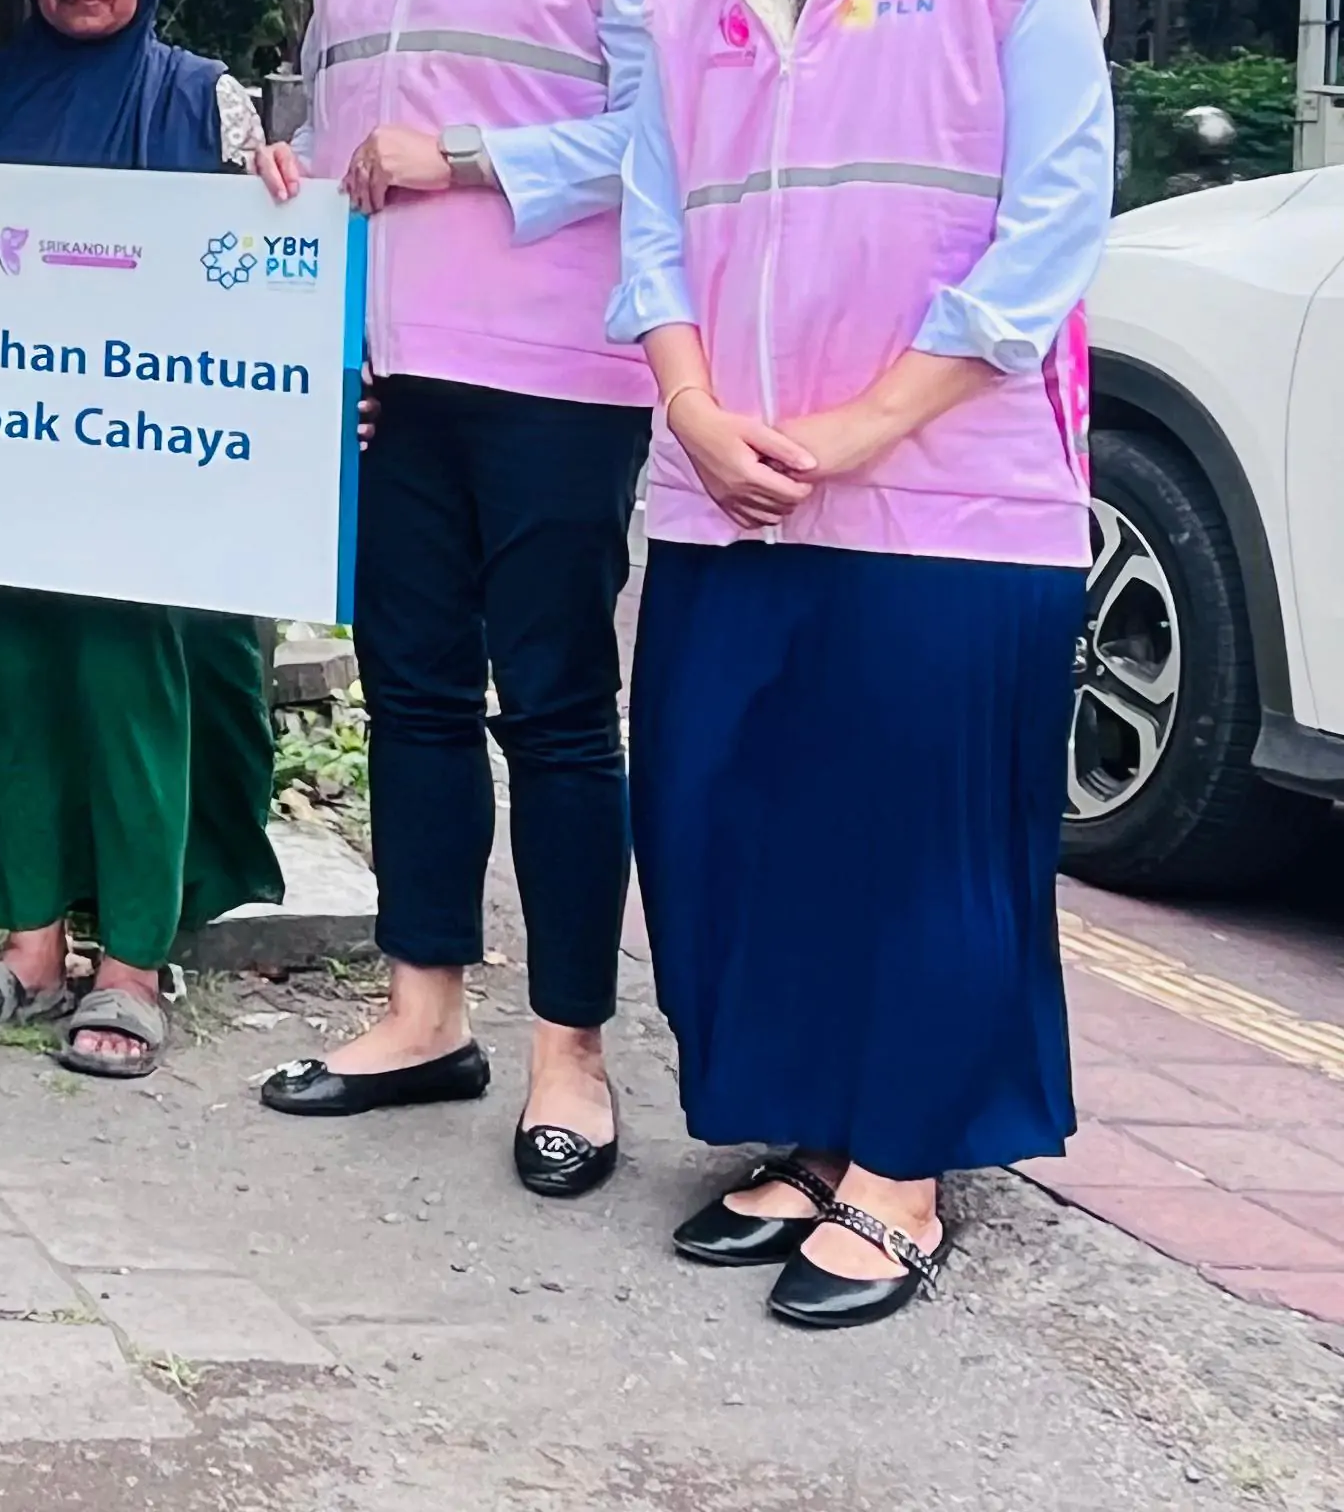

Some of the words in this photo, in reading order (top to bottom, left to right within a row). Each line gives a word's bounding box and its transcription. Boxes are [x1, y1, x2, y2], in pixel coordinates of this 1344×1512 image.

[39, 240, 109, 257] SRIKANDI
[114, 243, 142, 258] PLN
[264, 236, 319, 257] YBM
[266, 258, 318, 278] PLN
[104, 339, 310, 394] Bantuan
[74, 407, 251, 467] Cahaya
